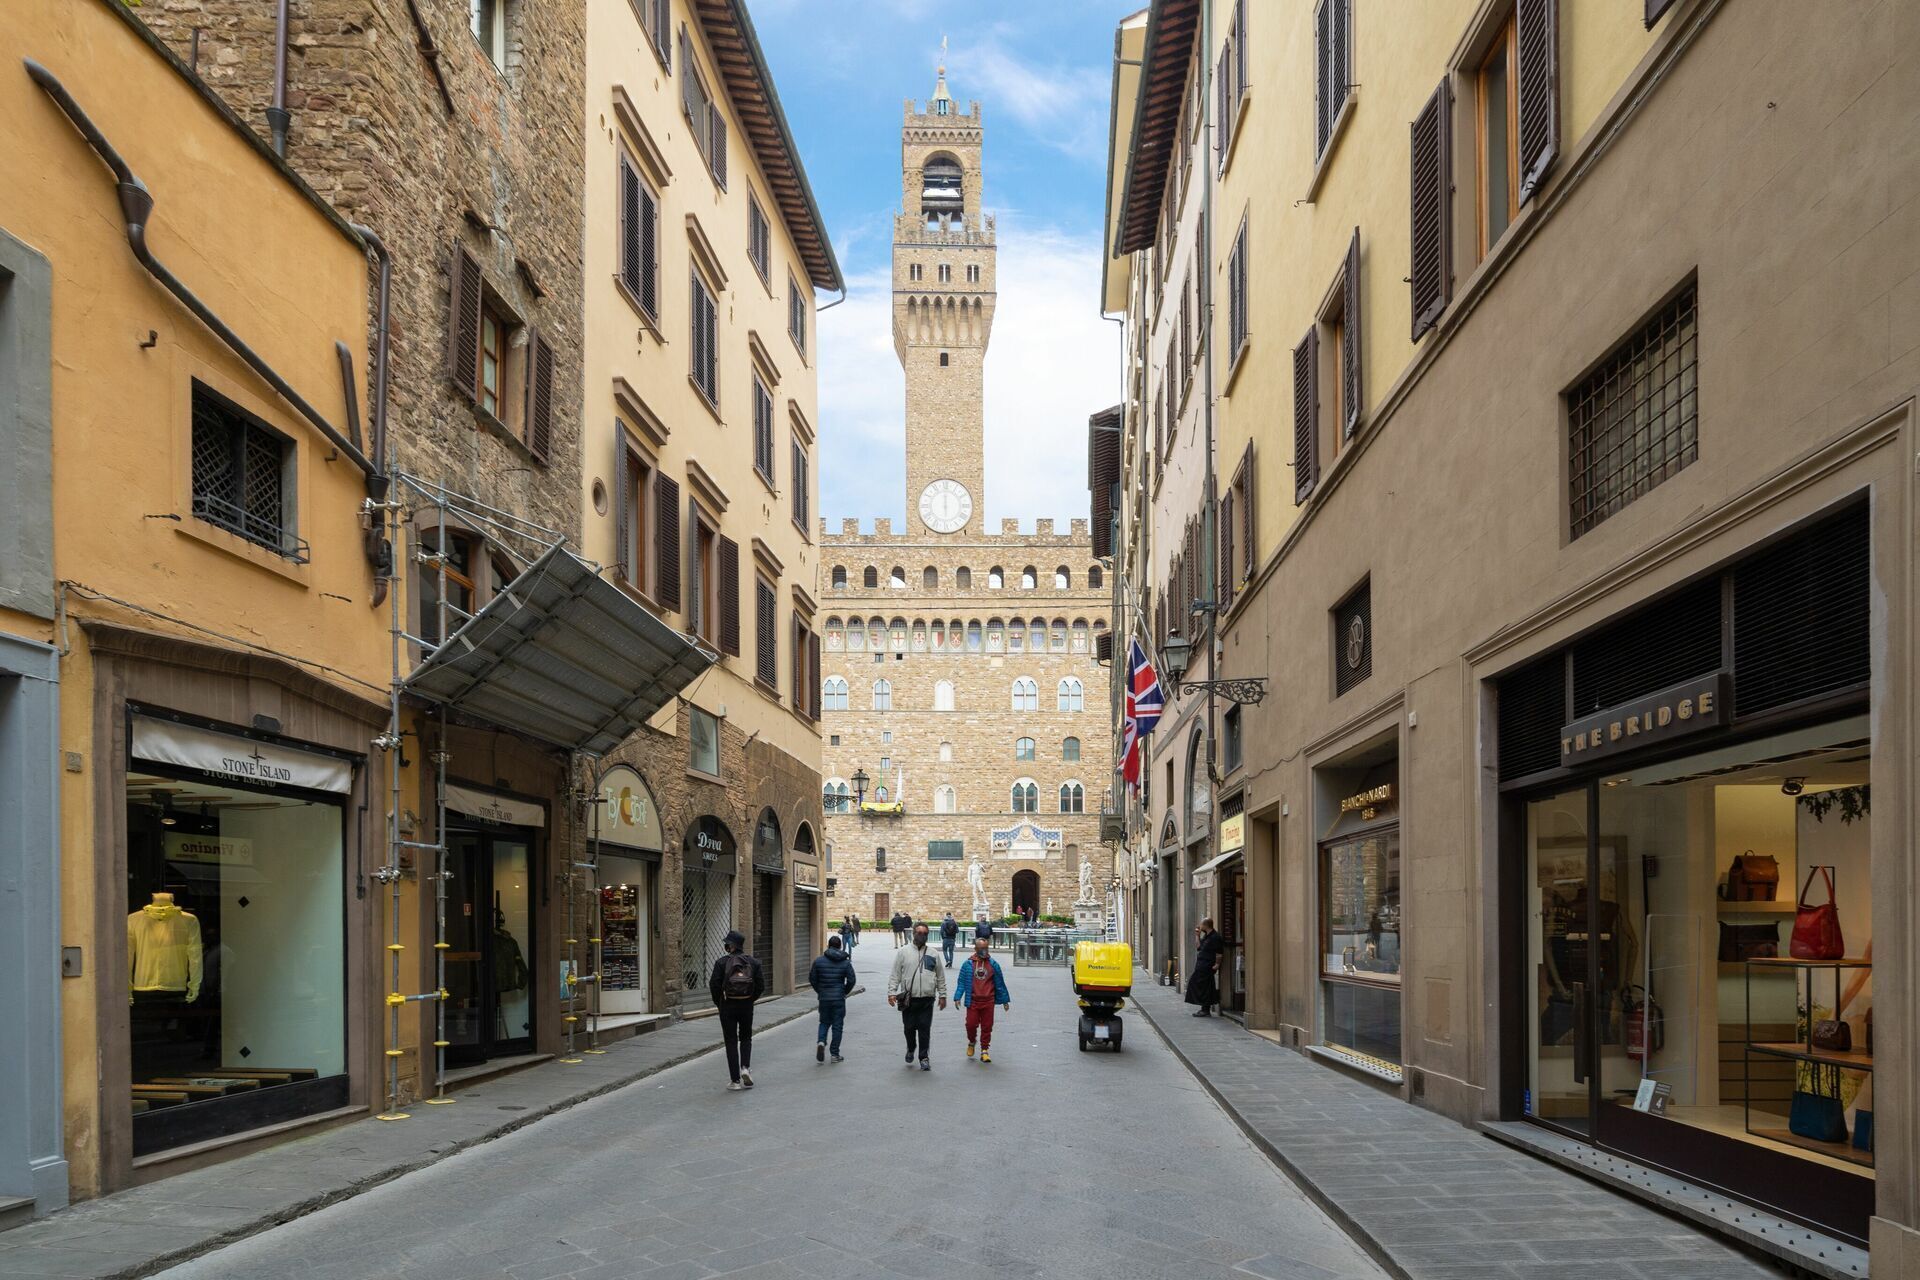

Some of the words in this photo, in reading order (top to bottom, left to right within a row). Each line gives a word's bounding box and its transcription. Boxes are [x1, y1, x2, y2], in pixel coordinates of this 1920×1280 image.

[1561, 727, 1602, 756] THE
[1609, 691, 1714, 742] BRIDGE
[222, 757, 255, 776] STONE
[259, 764, 291, 781] ISLAND
